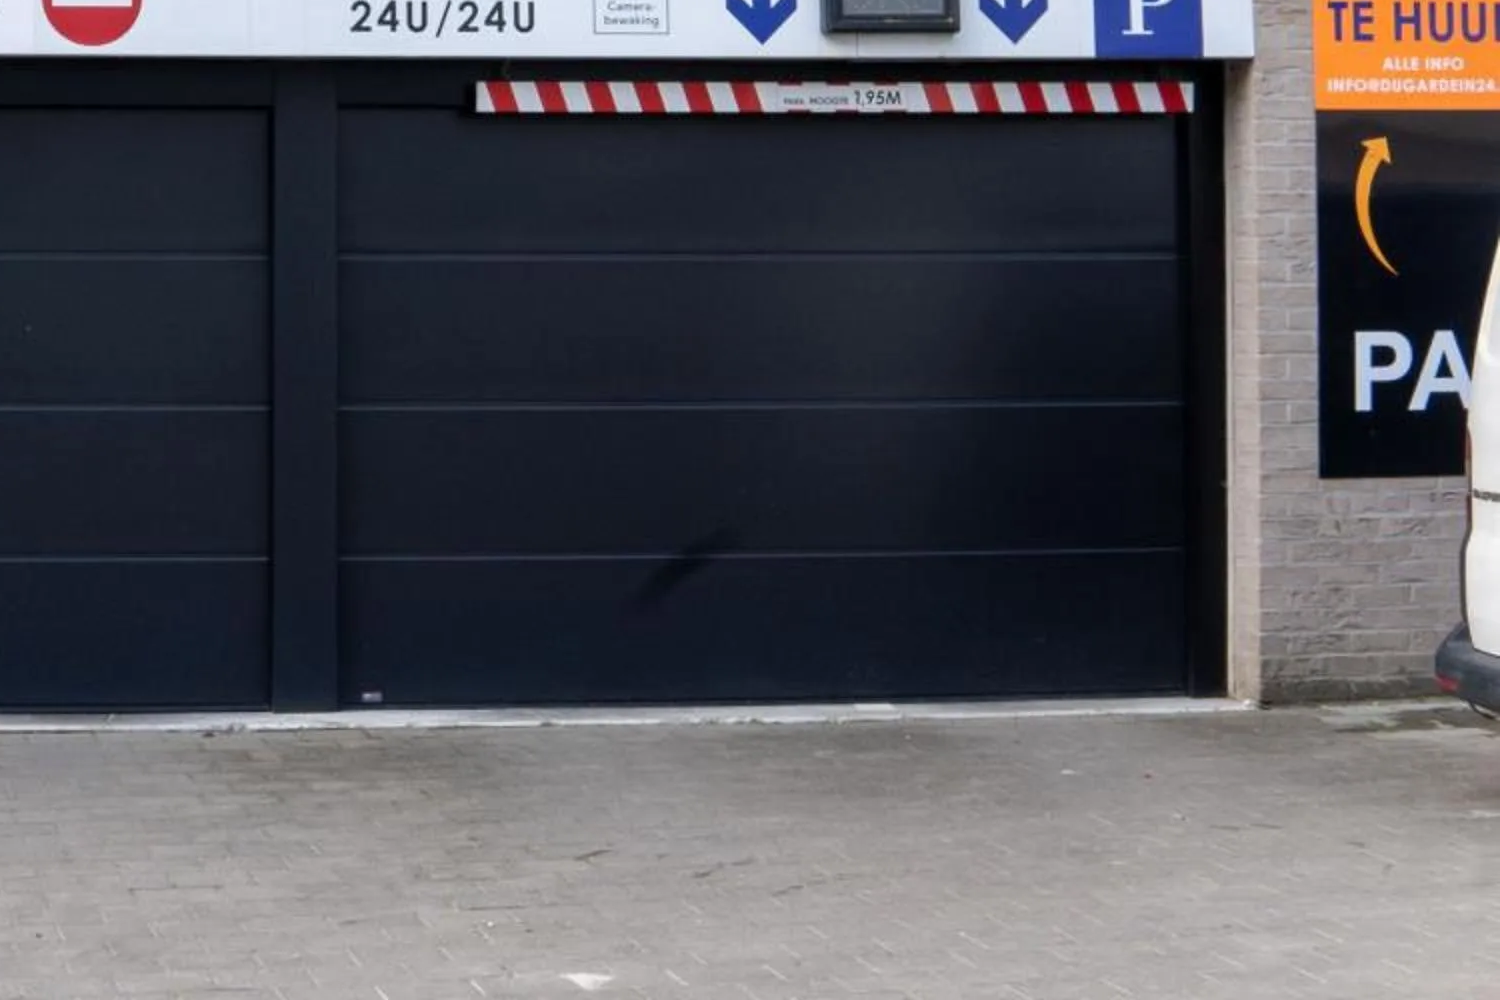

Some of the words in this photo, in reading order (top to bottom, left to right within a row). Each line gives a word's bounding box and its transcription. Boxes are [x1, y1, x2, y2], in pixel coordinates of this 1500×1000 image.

[350, 0, 536, 38] 24U/24U
[1327, 1, 1375, 41] TE
[1382, 56, 1419, 71] ALLE
[1425, 56, 1466, 71] INFO
